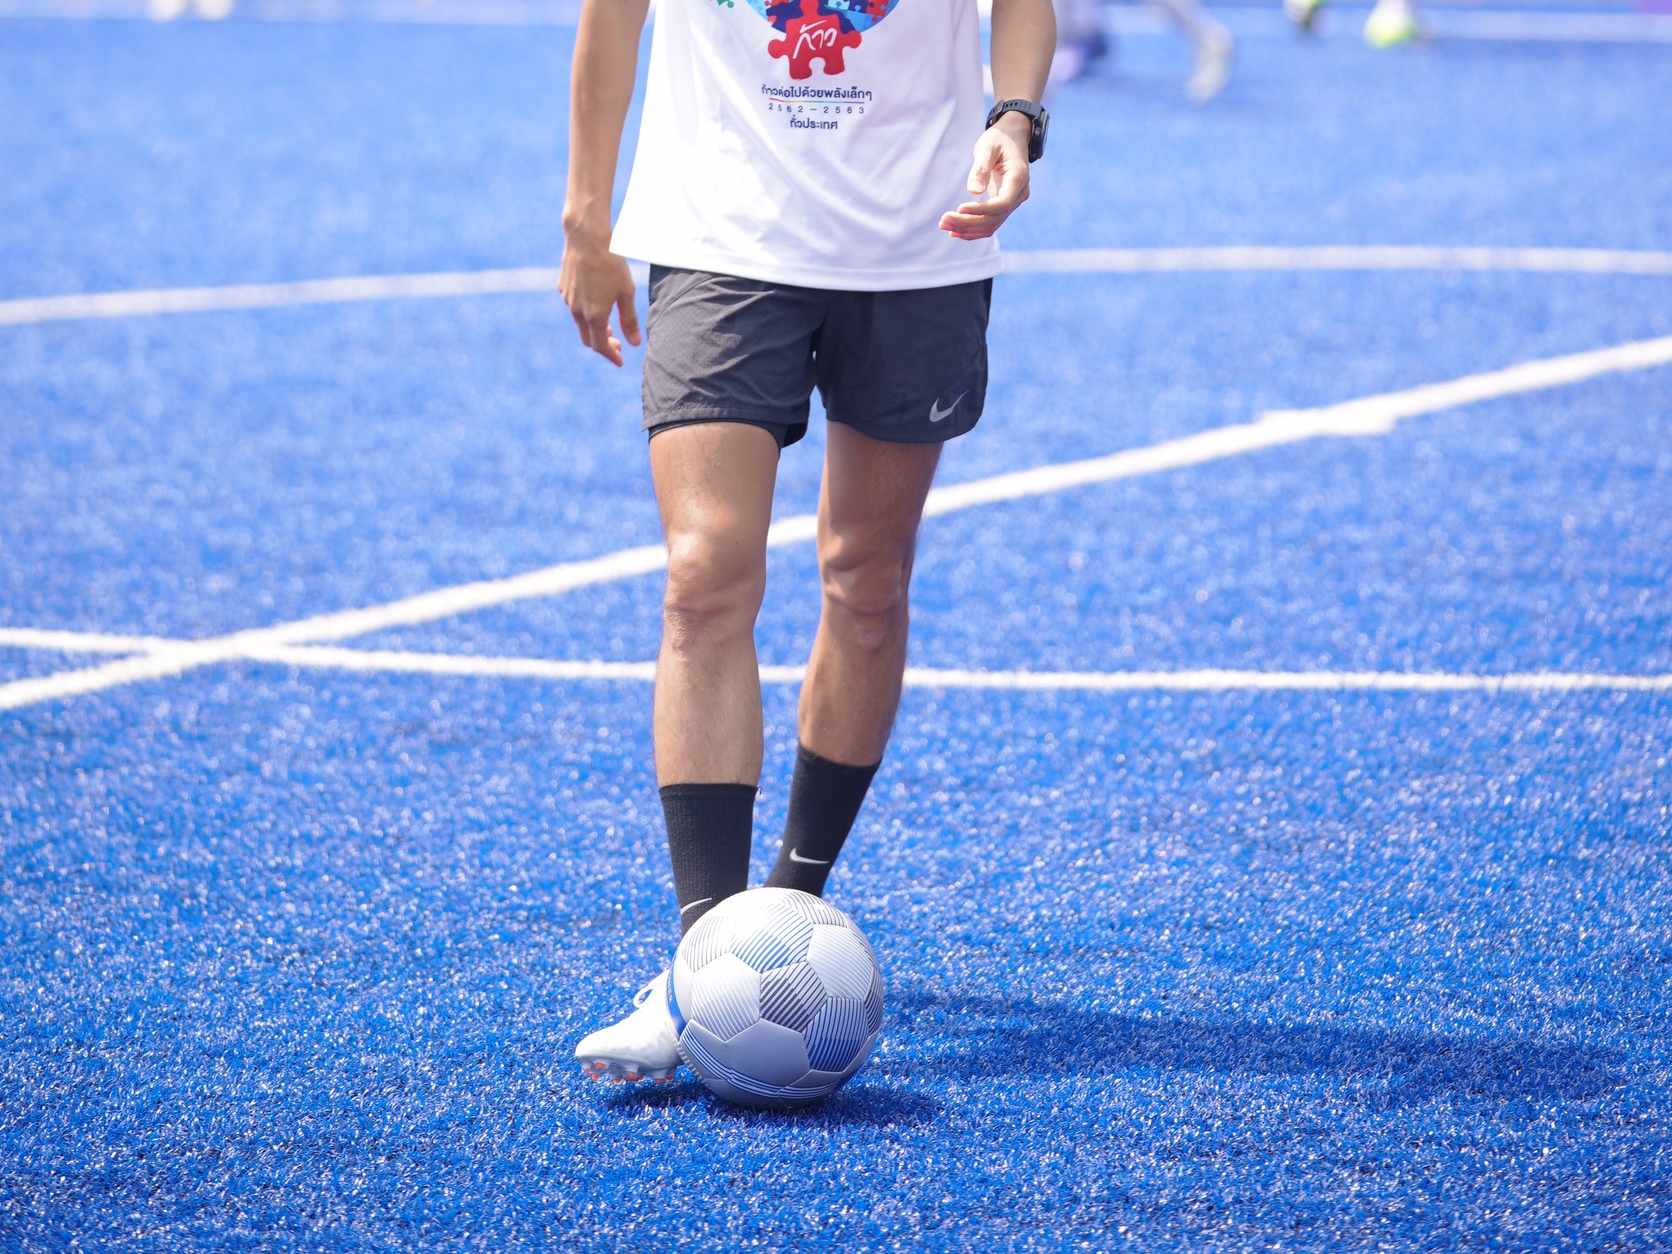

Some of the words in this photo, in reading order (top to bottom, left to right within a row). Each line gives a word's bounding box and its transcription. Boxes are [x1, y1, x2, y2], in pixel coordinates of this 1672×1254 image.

[792, 19, 838, 59] ก้าว
[789, 114, 838, 130] ทั่วประเทศ
